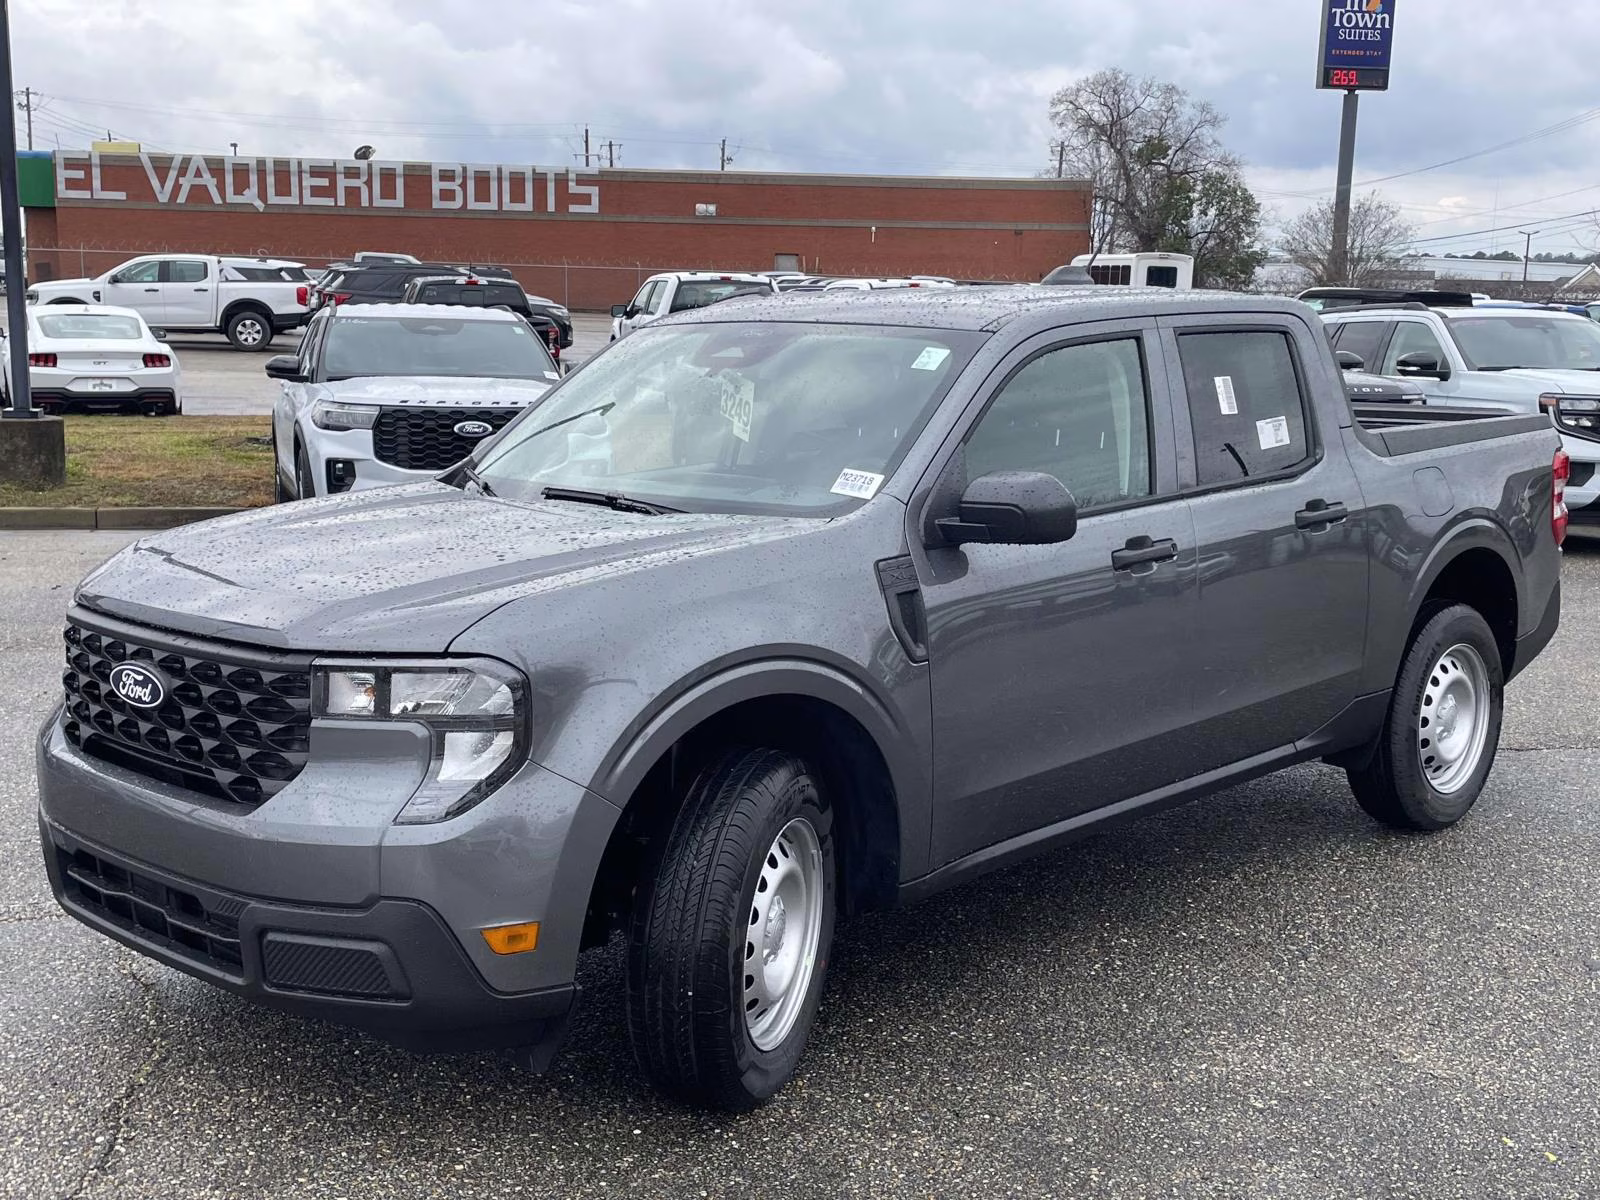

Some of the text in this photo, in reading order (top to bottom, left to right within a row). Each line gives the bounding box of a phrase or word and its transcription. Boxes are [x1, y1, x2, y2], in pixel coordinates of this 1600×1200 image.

[1338, 28, 1381, 40] SUITES
[56, 151, 599, 213] EL VAQUERO BOOTS
[722, 389, 751, 428] 3249
[840, 472, 875, 485] M23718
[119, 669, 152, 703] Ford
